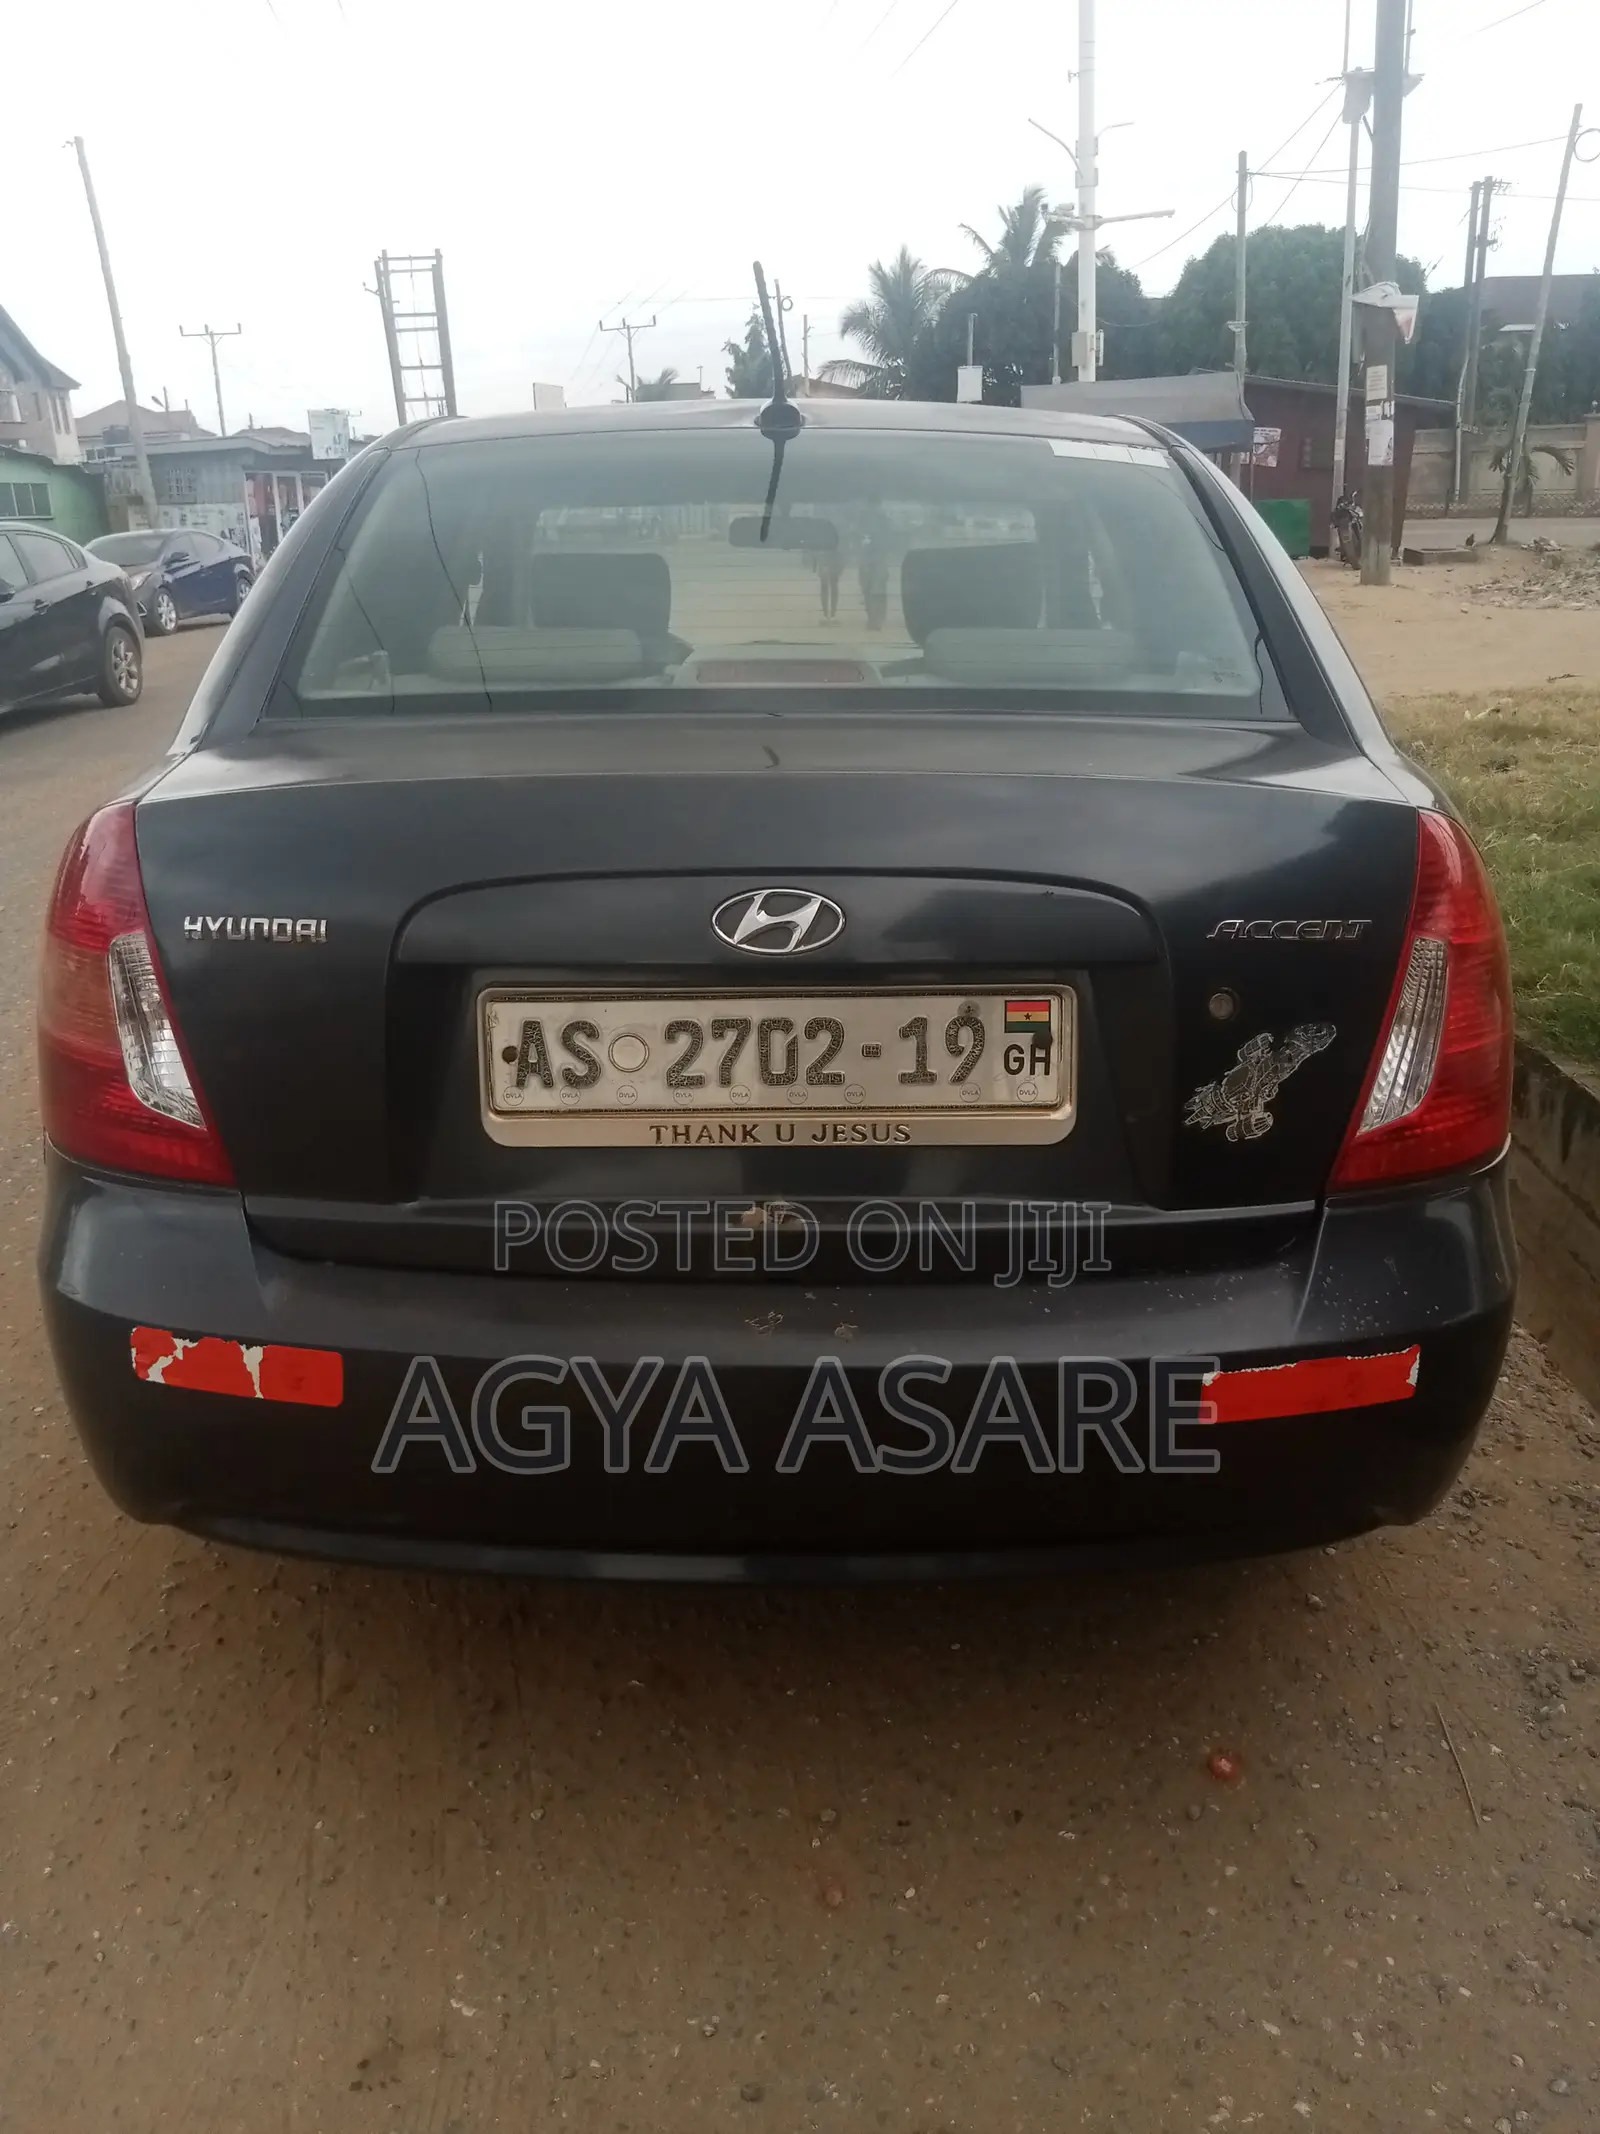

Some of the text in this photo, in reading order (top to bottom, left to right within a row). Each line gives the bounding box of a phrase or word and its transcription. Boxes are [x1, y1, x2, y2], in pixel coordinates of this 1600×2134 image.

[183, 915, 328, 942] HYUNDAI
[1206, 919, 1372, 939] ACCENT
[515, 1019, 601, 1088] AS
[1003, 1043, 1051, 1076] GH
[649, 1123, 912, 1145] THANK U JESUS
